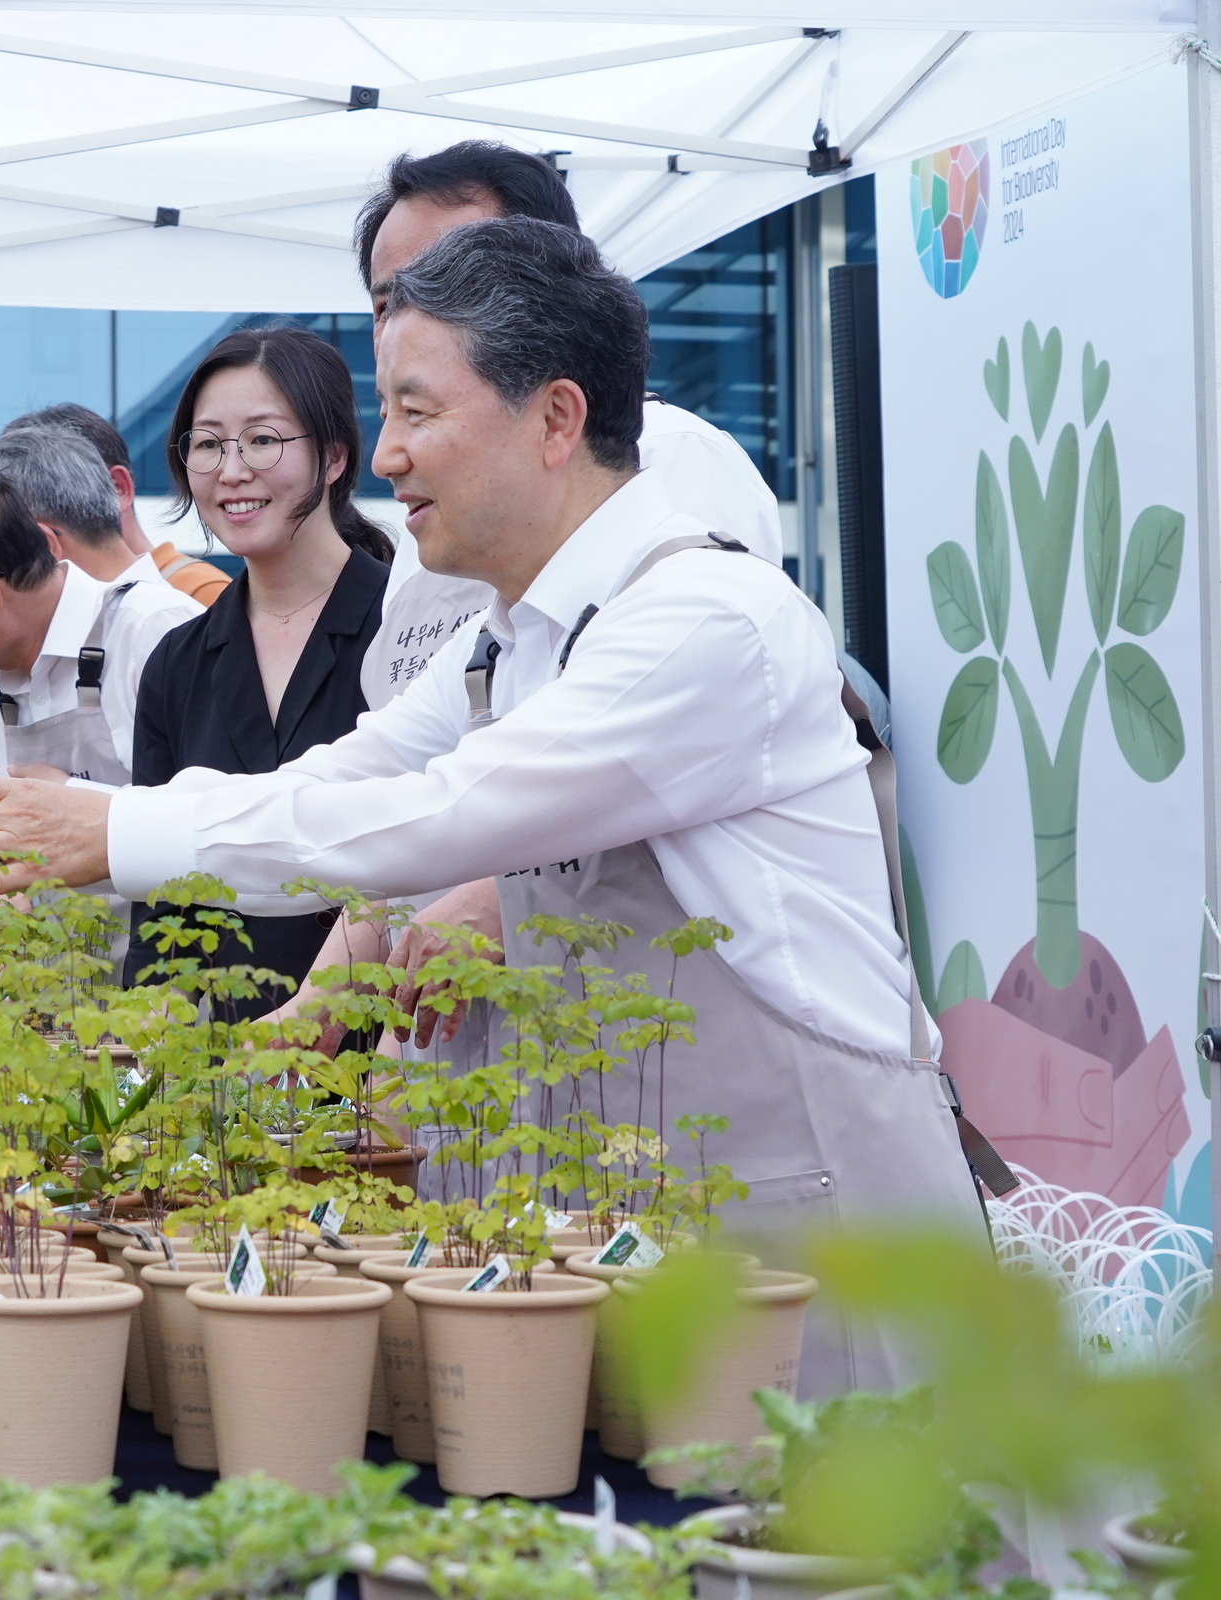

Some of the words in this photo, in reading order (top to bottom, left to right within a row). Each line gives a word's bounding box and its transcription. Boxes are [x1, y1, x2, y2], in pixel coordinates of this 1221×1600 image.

[1001, 125, 1050, 169] International
[1051, 117, 1067, 149] Day
[1002, 178, 1014, 206] for
[1014, 159, 1060, 202] Biodiversity
[1003, 209, 1024, 244] 2024
[396, 618, 444, 648] 나무야
